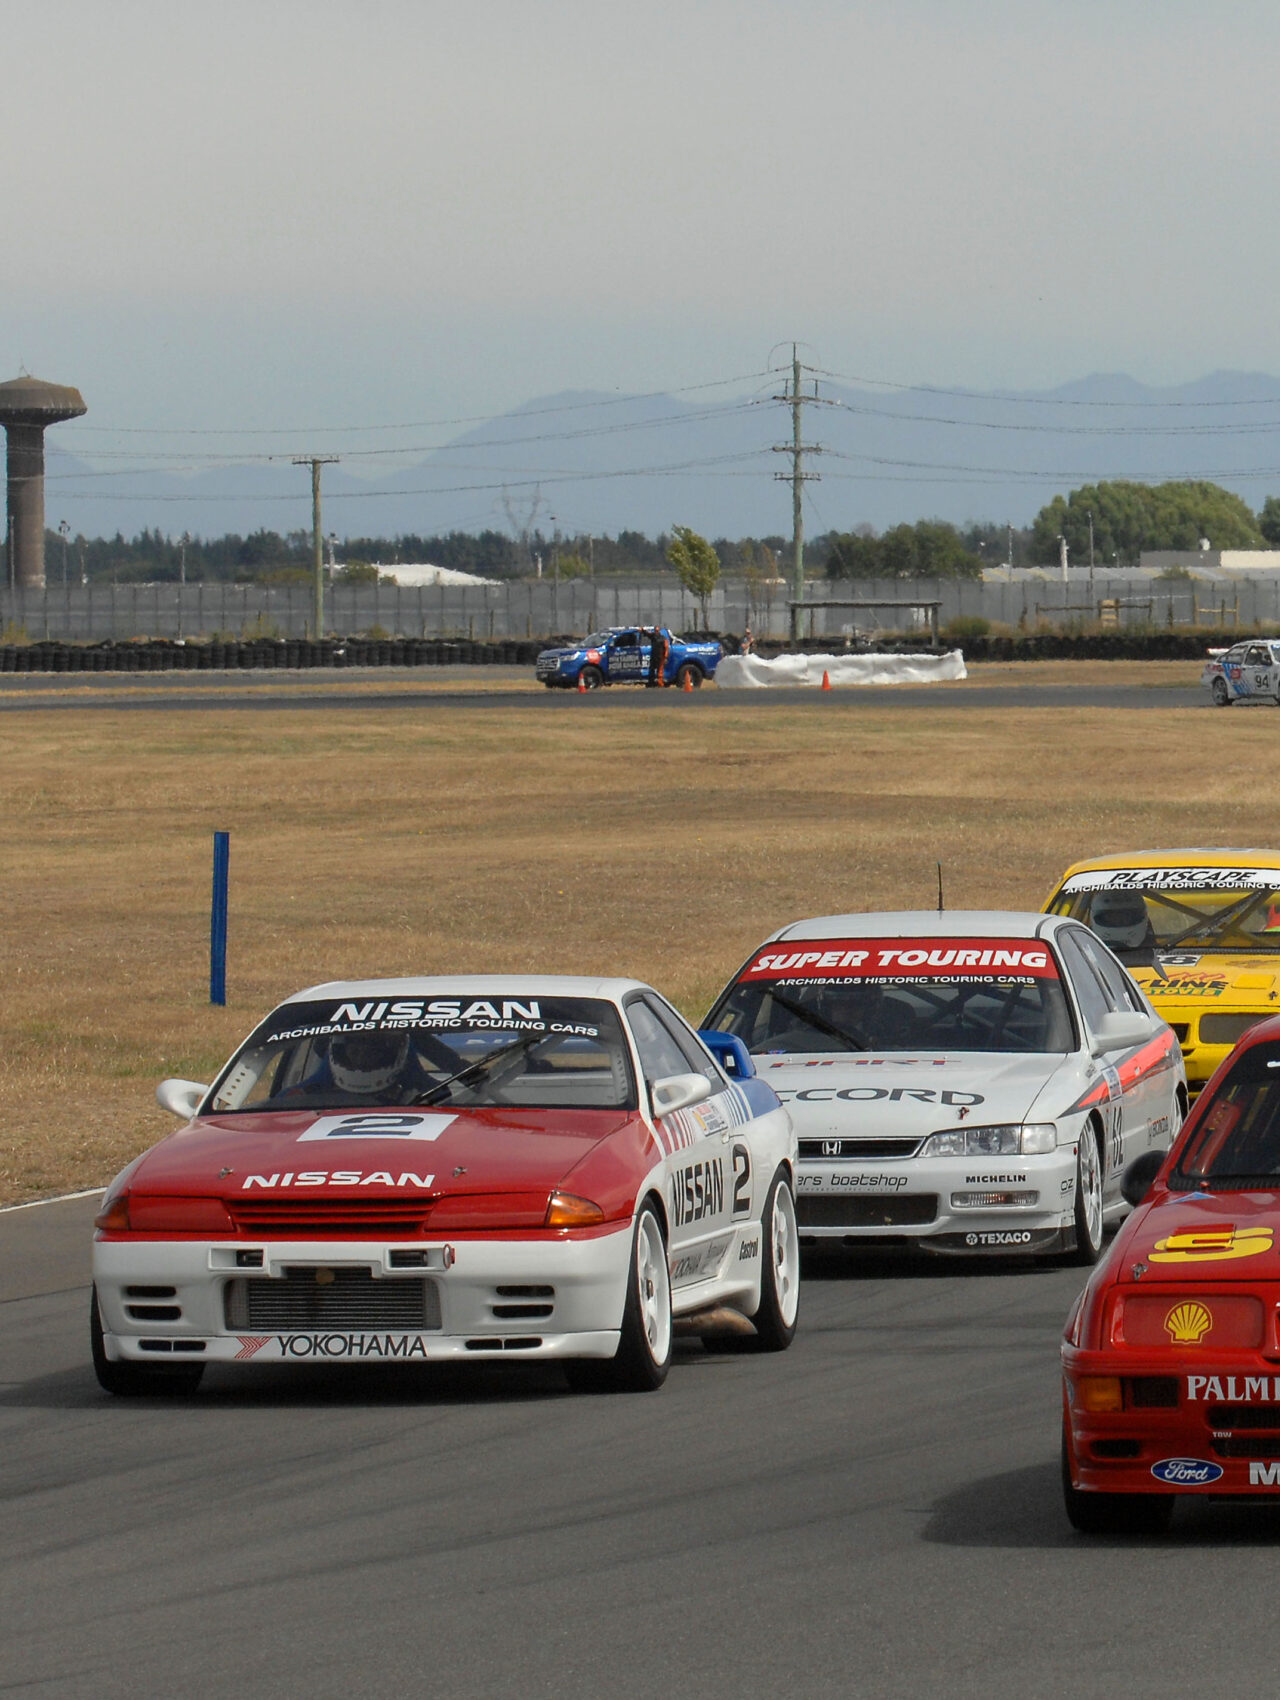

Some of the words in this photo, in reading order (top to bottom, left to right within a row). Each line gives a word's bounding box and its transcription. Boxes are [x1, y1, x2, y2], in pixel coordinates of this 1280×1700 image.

[1255, 674, 1269, 689] 94
[1109, 871, 1258, 884] PLAYSCAPE
[1066, 882, 1145, 895] ARCHIBALDS
[1146, 881, 1205, 890] HISTORIC
[1210, 881, 1266, 891] TOURING
[751, 950, 870, 973] SUPER
[877, 950, 1047, 968] TOURING
[776, 977, 862, 987] ARCHIBALDS
[865, 975, 928, 985] HISTORIC
[932, 975, 994, 984] TOURING
[997, 975, 1036, 984] CARS
[330, 1001, 541, 1022] NISSAN
[267, 1021, 375, 1043] ARCHIBALDS
[380, 1018, 460, 1030] HISTORIC
[467, 1018, 545, 1031] TOURING
[550, 1023, 599, 1037] CARS
[776, 1087, 985, 1107] CCORD
[327, 1115, 424, 1137] 2
[242, 1170, 435, 1189] NISSAN
[733, 1143, 750, 1214] 2
[797, 1176, 822, 1187] ers
[830, 1173, 908, 1192] boatshop
[966, 1174, 1026, 1184] MICHELIN
[1060, 1178, 1074, 1191] OZ
[671, 1158, 724, 1228] NISSAN
[979, 1231, 1031, 1245] TEXACO
[277, 1334, 428, 1358] YOKOHAMA
[1164, 1461, 1208, 1482] Ford
